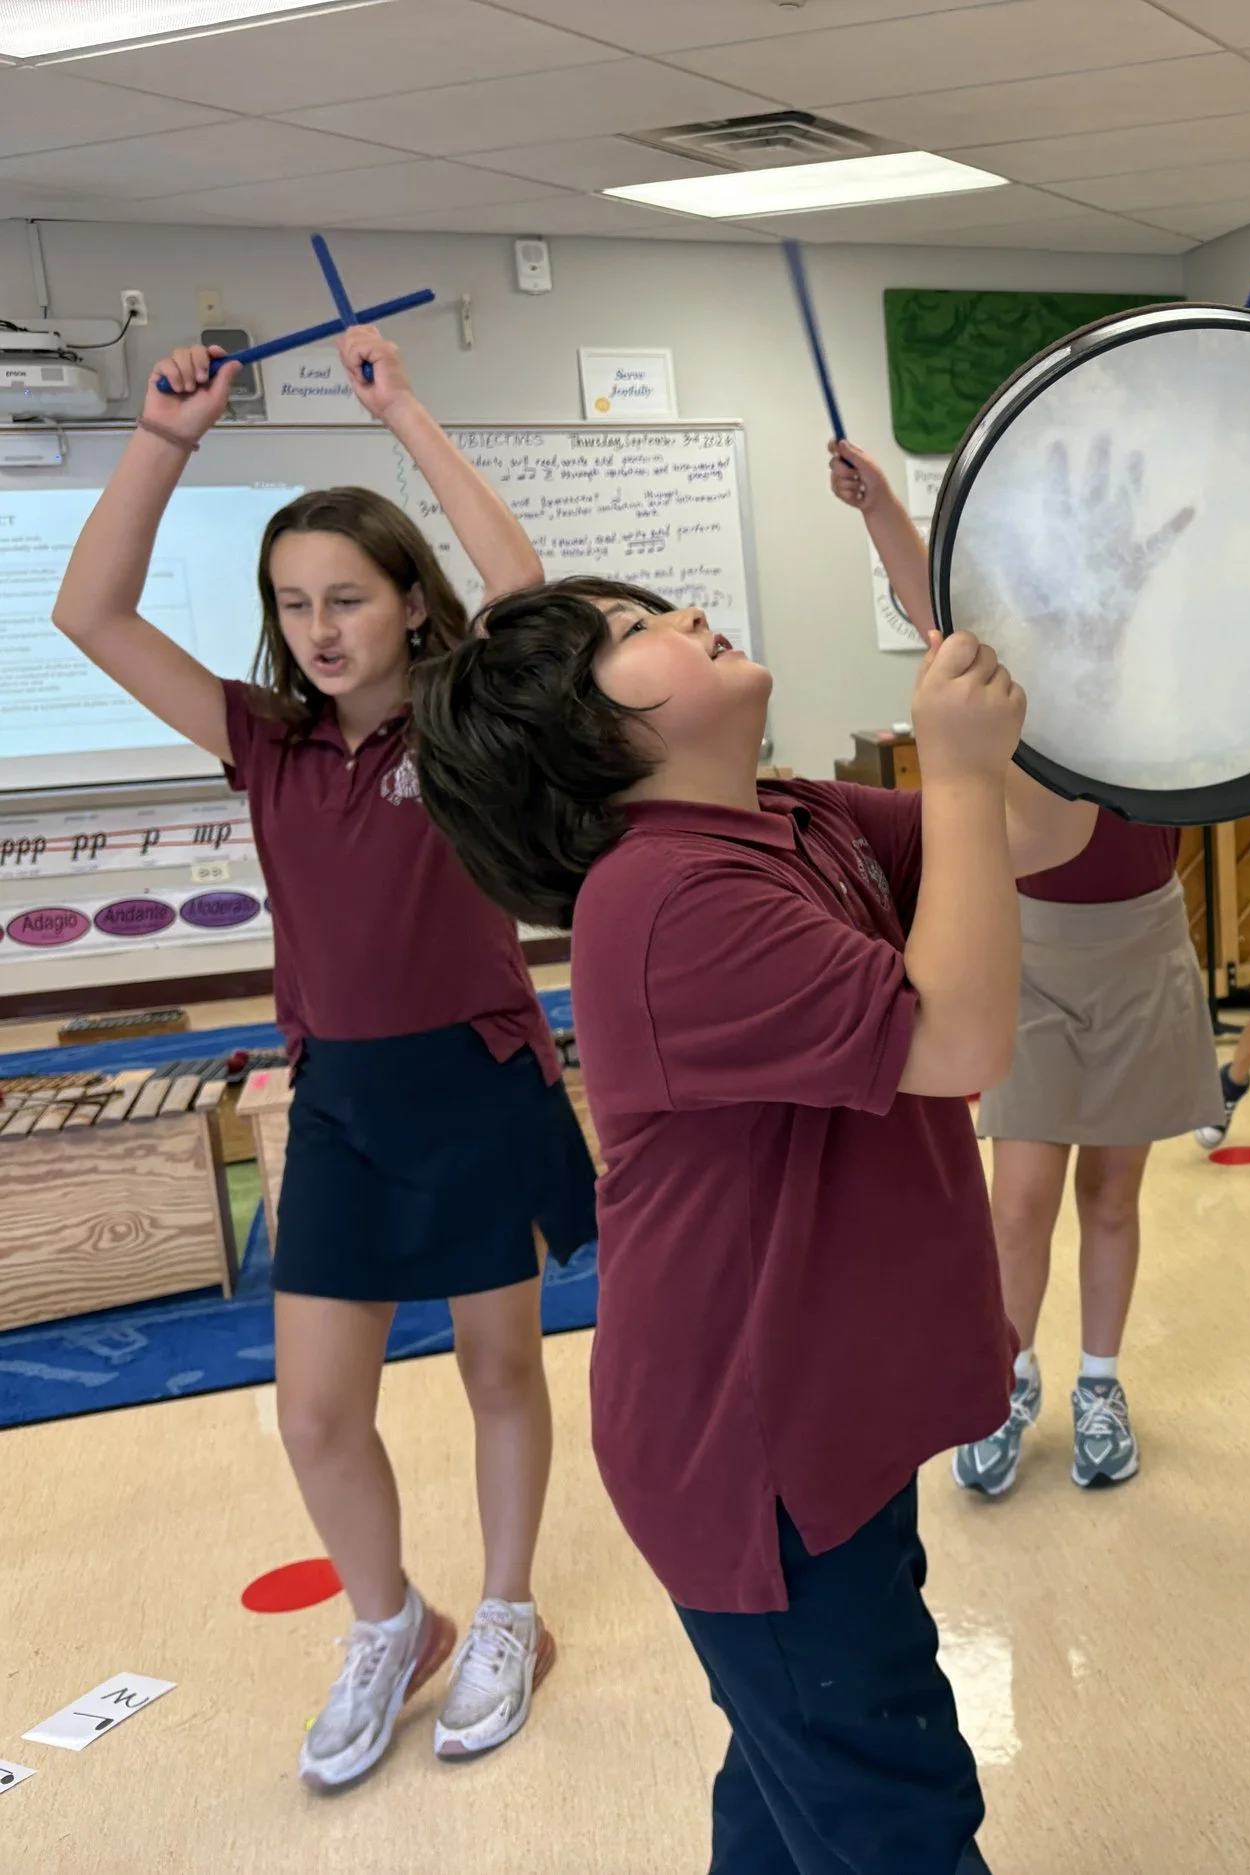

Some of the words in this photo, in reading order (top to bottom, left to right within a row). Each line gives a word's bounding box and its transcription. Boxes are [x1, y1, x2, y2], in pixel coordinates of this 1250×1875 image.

[72, 832, 107, 861] pp
[141, 828, 160, 855] p
[193, 823, 232, 849] mp
[23, 914, 78, 934] Adagio
[103, 904, 168, 923] Andante
[190, 898, 256, 917] Moderato
